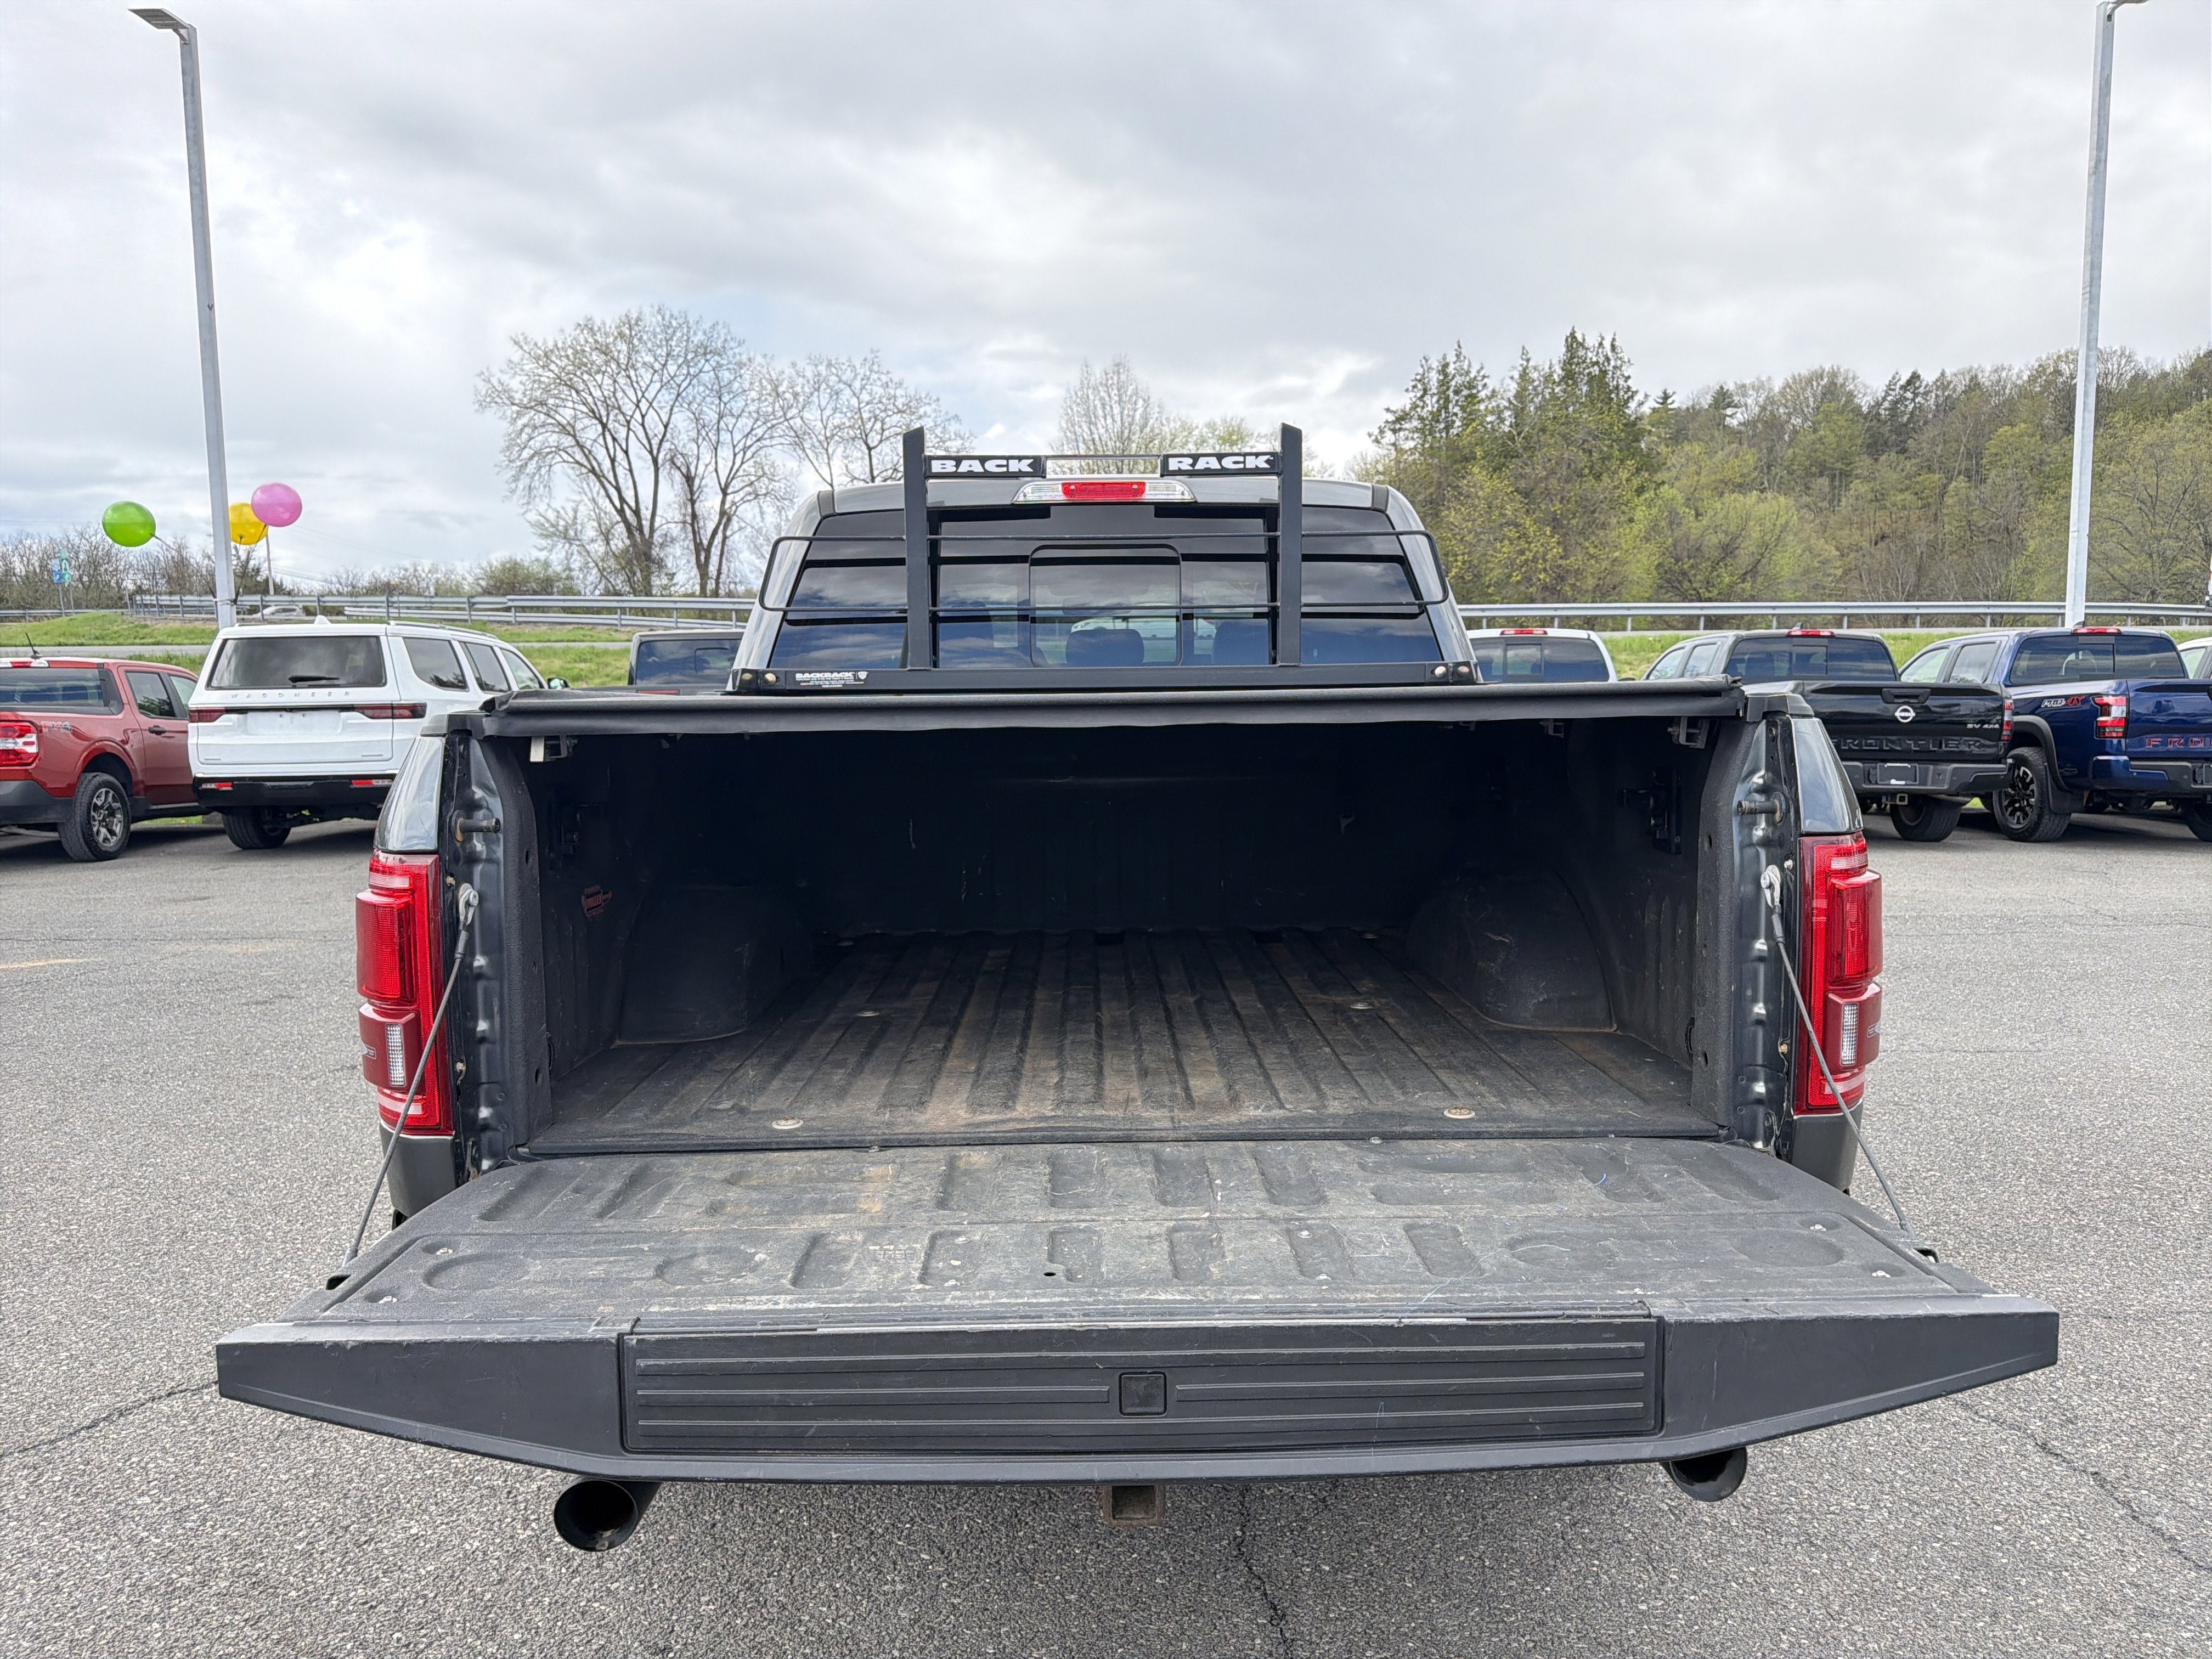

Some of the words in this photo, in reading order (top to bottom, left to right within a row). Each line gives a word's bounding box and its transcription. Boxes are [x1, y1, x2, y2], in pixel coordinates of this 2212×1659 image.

[931, 459, 1034, 472] BACK
[1168, 455, 1271, 470] RACK
[2146, 738, 2212, 748] FRO
